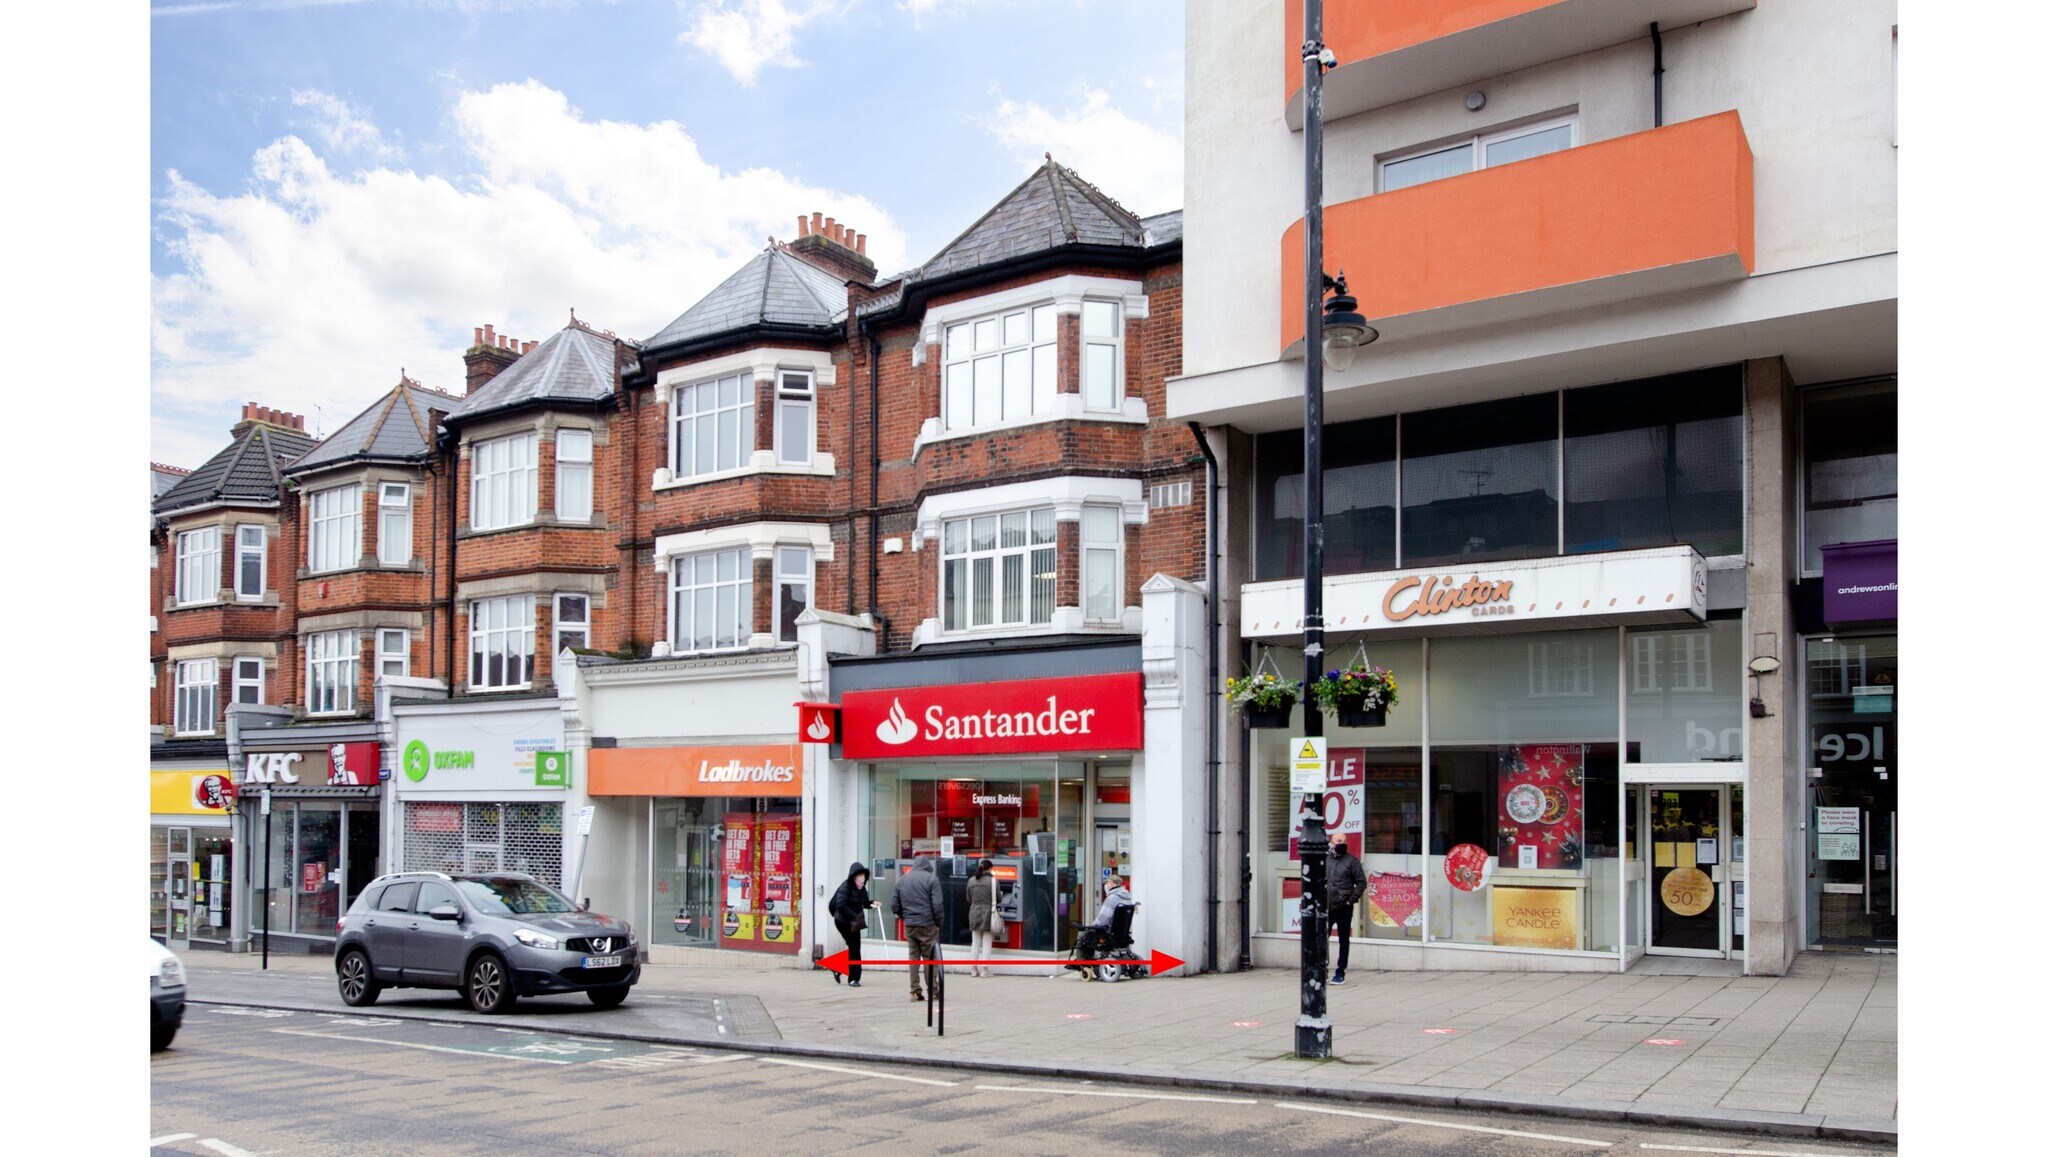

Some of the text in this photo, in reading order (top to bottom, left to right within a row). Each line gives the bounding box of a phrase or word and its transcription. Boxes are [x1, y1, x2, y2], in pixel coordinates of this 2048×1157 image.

[1382, 575, 1514, 622] Clinton
[1471, 605, 1515, 617] CARDS
[925, 695, 1095, 741] Santander
[245, 752, 300, 784] KFC
[433, 751, 474, 769] OXFAM
[698, 760, 795, 782] Ladbrokes
[1327, 757, 1357, 782] LE
[972, 793, 1022, 807] Express Banking
[1344, 820, 1361, 829] OFF
[1670, 890, 1693, 905] 50
[587, 957, 606, 967] LS62
